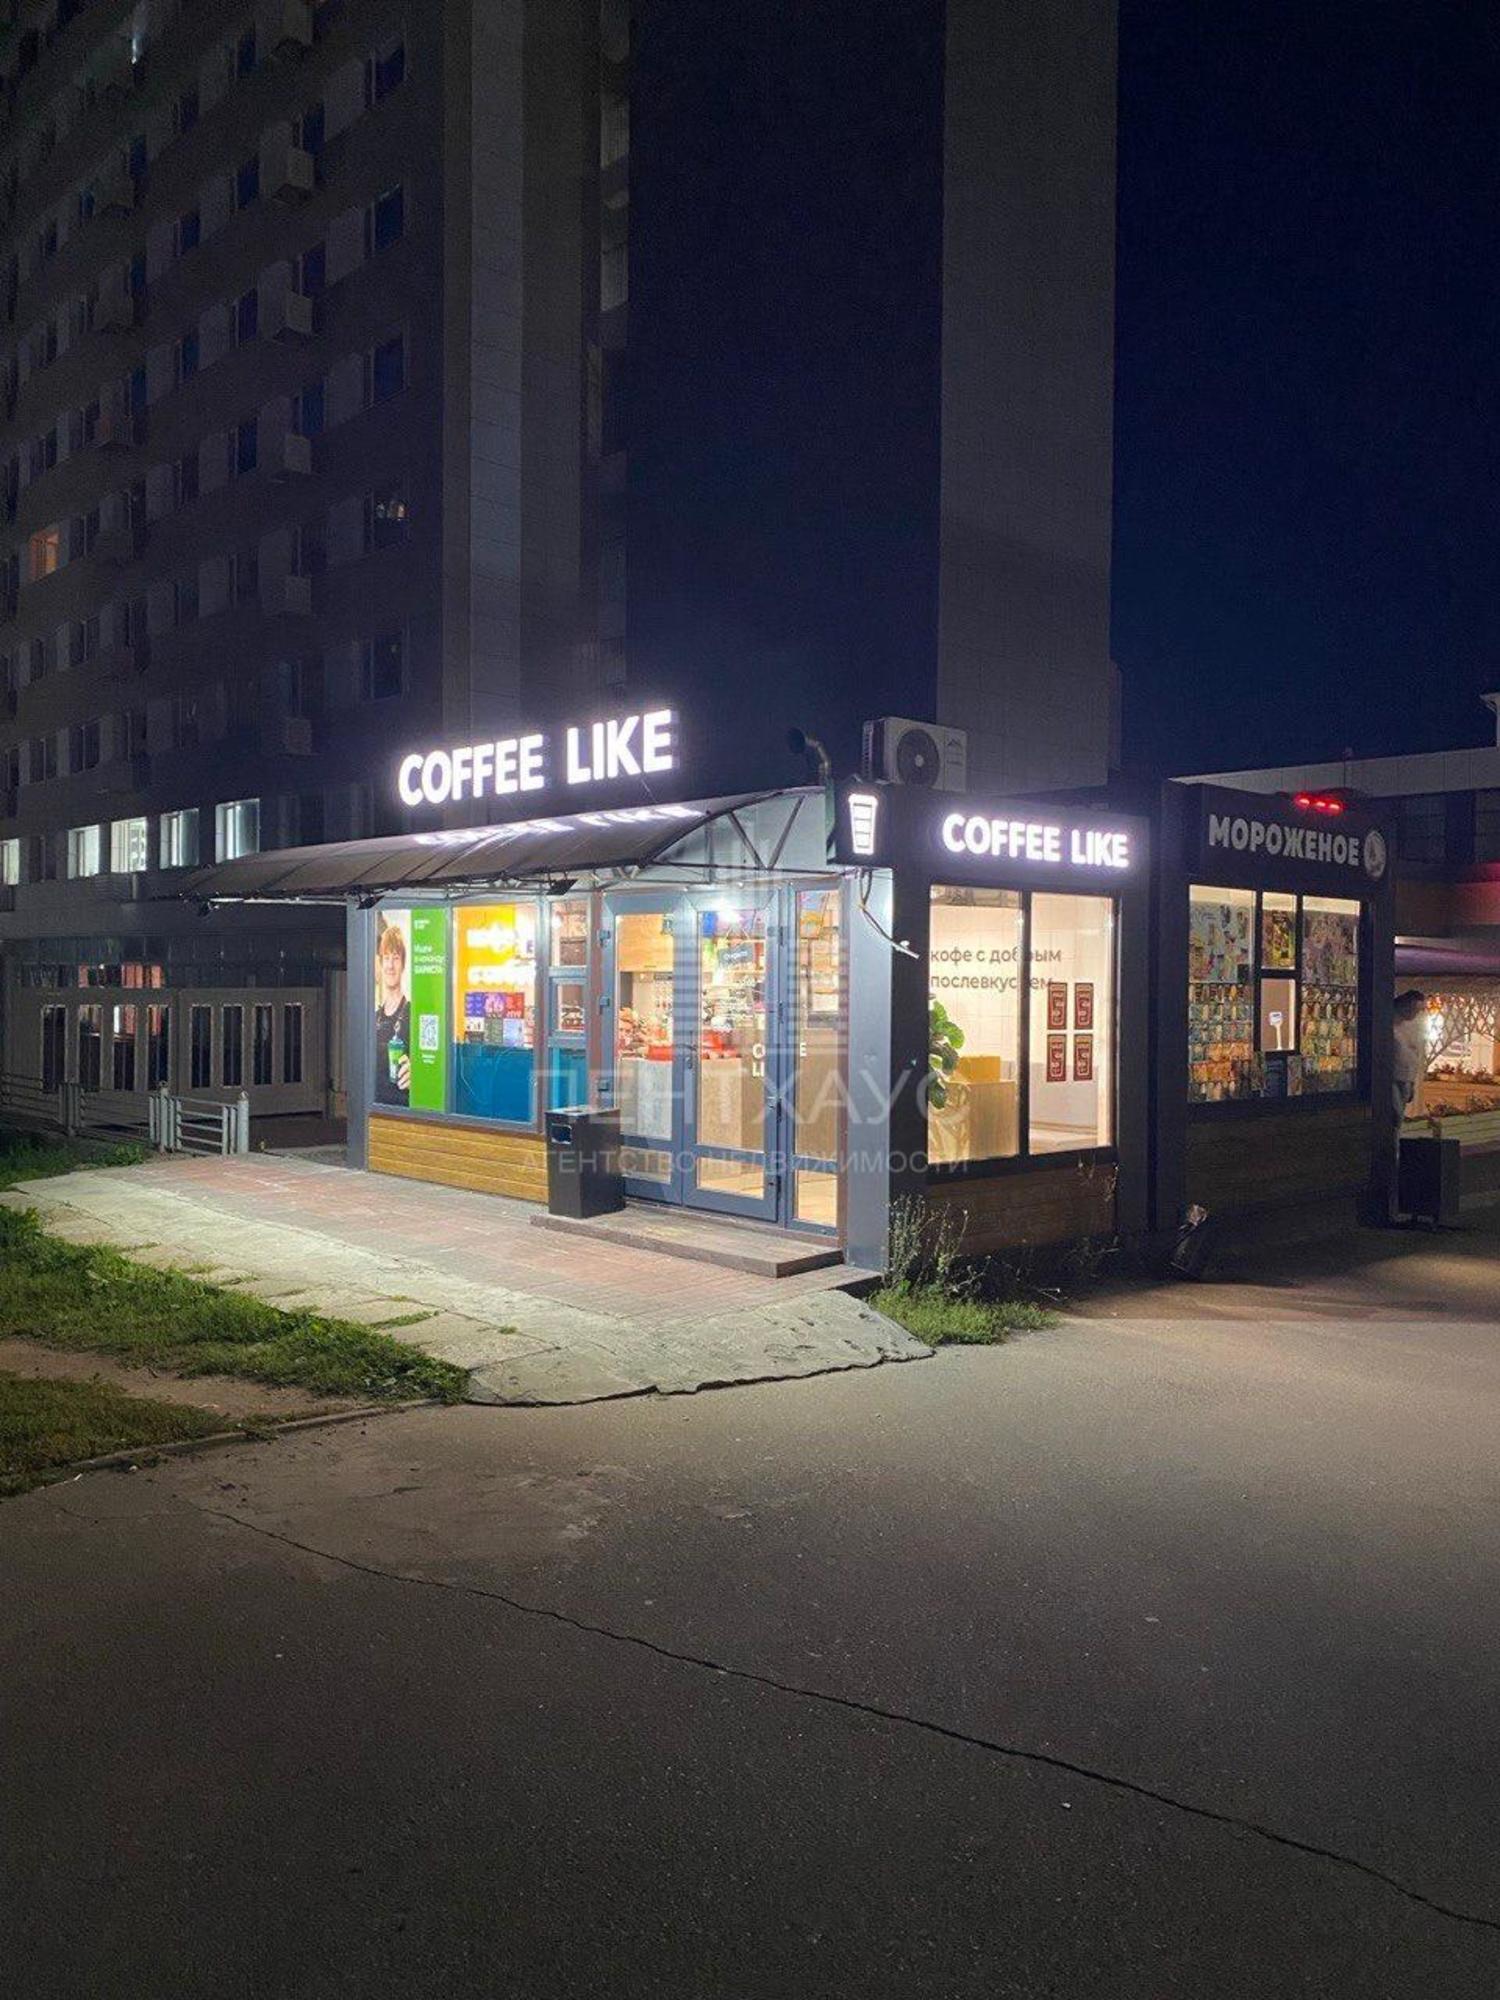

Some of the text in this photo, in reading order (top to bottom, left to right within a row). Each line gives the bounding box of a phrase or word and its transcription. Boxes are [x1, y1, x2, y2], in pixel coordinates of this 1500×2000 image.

[399, 709, 674, 807] COFFEE LIKE
[942, 813, 1130, 868] COFFEE LIKE
[1208, 813, 1361, 867] МОРОЖЕНОЕ
[930, 946, 1062, 966] кофе с добым
[930, 974, 1053, 993] послевкусем
